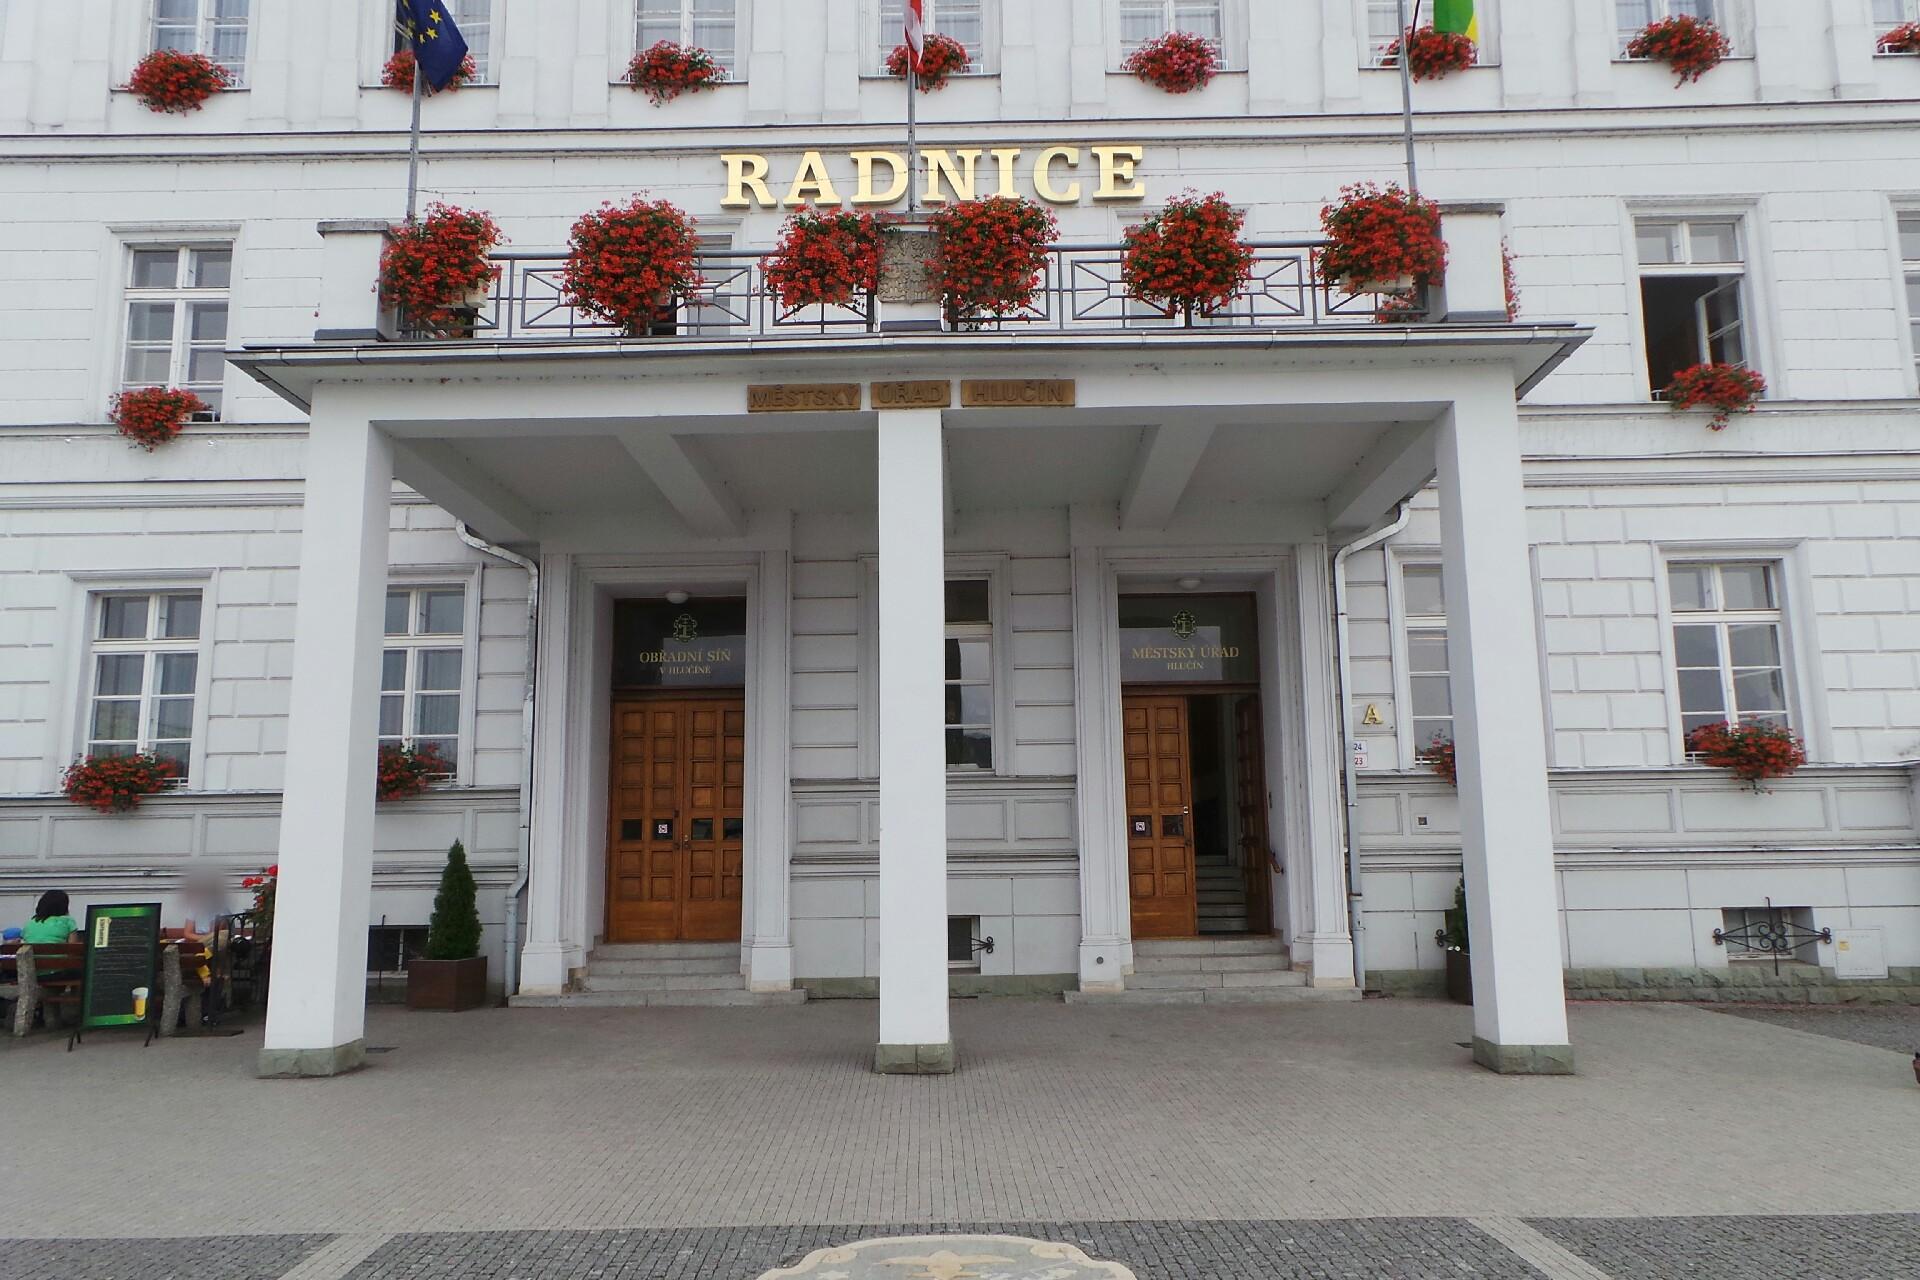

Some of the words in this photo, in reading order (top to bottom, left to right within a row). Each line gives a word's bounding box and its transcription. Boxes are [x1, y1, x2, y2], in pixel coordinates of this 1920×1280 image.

[719, 146, 1146, 208] RADNICE
[749, 384, 857, 409] MĚSTSKÝ
[877, 383, 944, 404] ÚŘAD
[973, 380, 1064, 403] HLUČÍN
[639, 648, 702, 663] OBŘADNÍ
[1362, 703, 1383, 725] A
[1354, 757, 1363, 765] 23
